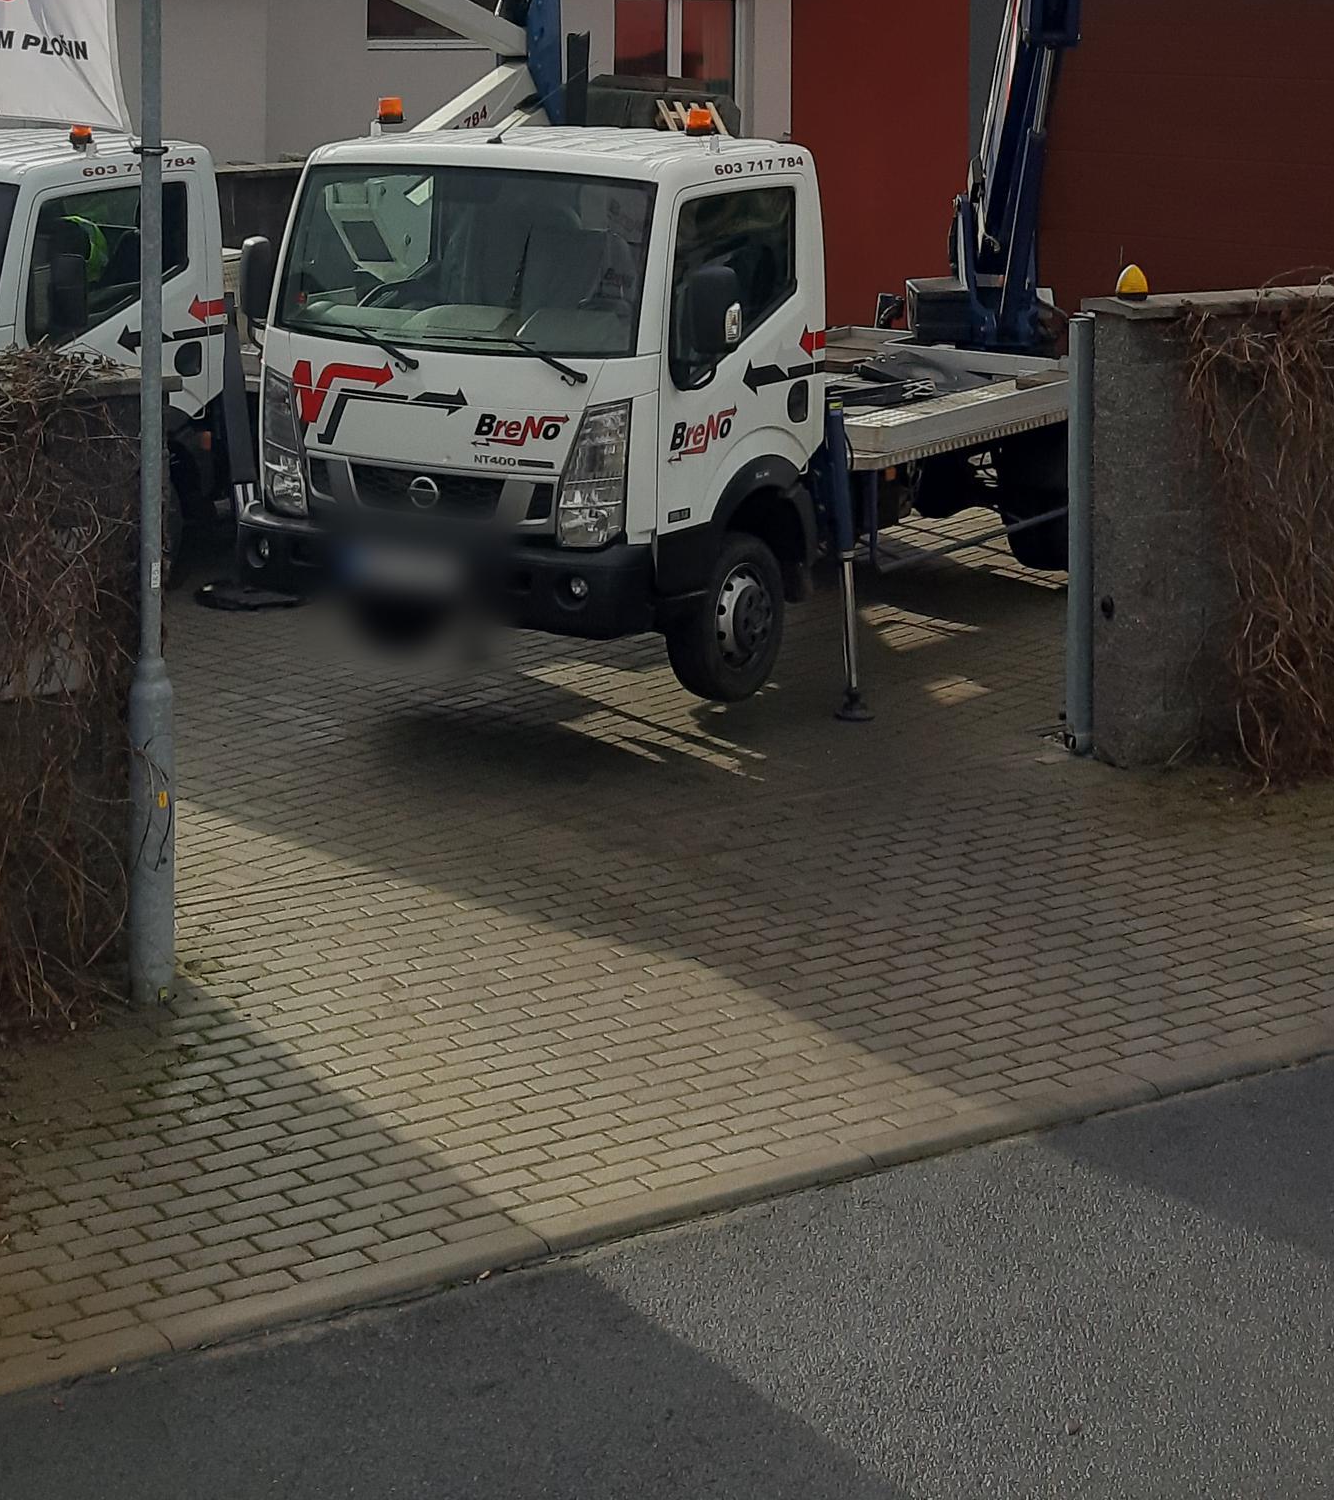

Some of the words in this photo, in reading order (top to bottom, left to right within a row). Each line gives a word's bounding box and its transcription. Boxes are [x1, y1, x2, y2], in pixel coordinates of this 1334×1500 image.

[82, 164, 118, 177] 603
[123, 161, 142, 172] 71
[164, 156, 196, 168] 784
[714, 162, 743, 175] 603
[747, 159, 773, 172] 717
[778, 156, 804, 168] 784
[473, 413, 567, 446] BreNo
[669, 410, 735, 454] BreNo
[474, 454, 517, 467] NT400
